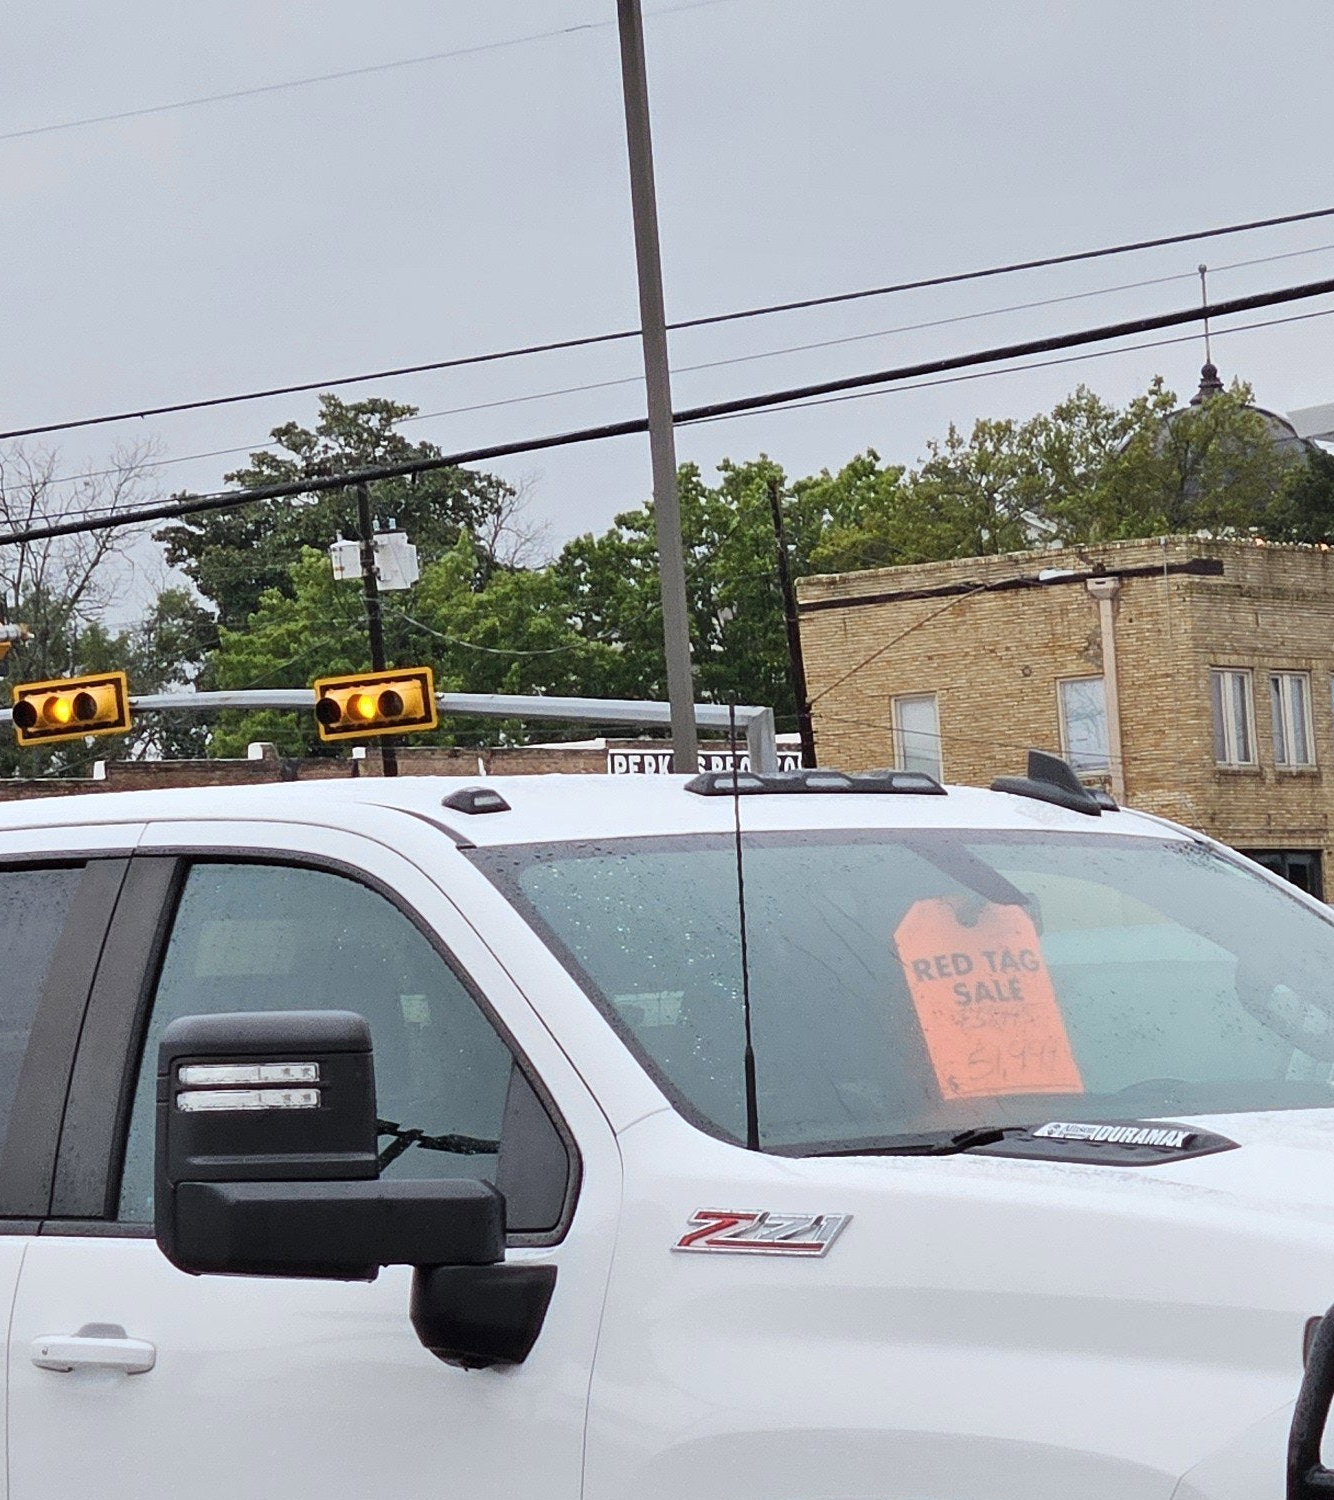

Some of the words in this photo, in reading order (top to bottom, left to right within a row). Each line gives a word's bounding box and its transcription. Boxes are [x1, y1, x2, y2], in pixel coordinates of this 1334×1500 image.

[911, 952, 974, 983] RED
[981, 948, 1040, 974] TAG
[953, 977, 1025, 1007] SALE
[1097, 1126, 1191, 1148] DURAMAX
[668, 1207, 854, 1258] Z71
